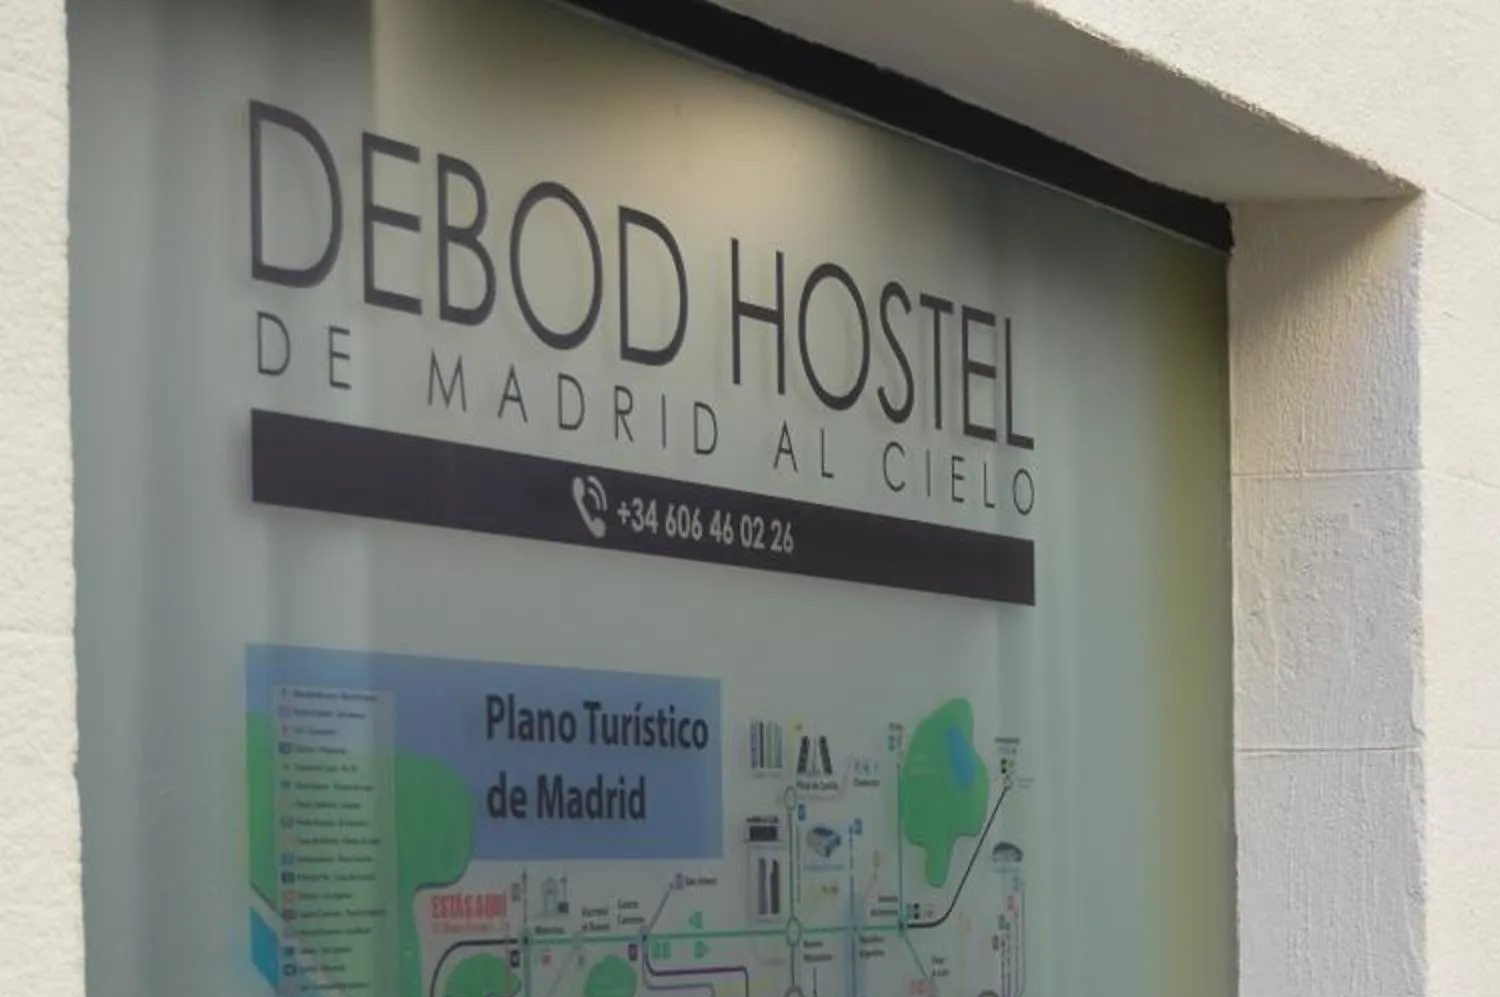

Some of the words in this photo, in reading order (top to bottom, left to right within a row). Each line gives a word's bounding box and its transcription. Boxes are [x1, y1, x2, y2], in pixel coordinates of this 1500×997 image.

[249, 98, 689, 367] DEBOD
[730, 237, 1036, 451] HOSTEL
[256, 311, 353, 391] DE
[427, 349, 719, 456] MADRID
[773, 420, 835, 479] AL
[882, 440, 1036, 516] CIELO
[616, 496, 659, 534] +34
[665, 503, 703, 541] 606
[709, 508, 734, 545] 46
[740, 513, 766, 550] 02
[770, 518, 795, 554] 26
[485, 692, 577, 745] Plano
[582, 699, 710, 751] Turístico
[486, 769, 528, 820] de
[535, 773, 647, 821] Madrid
